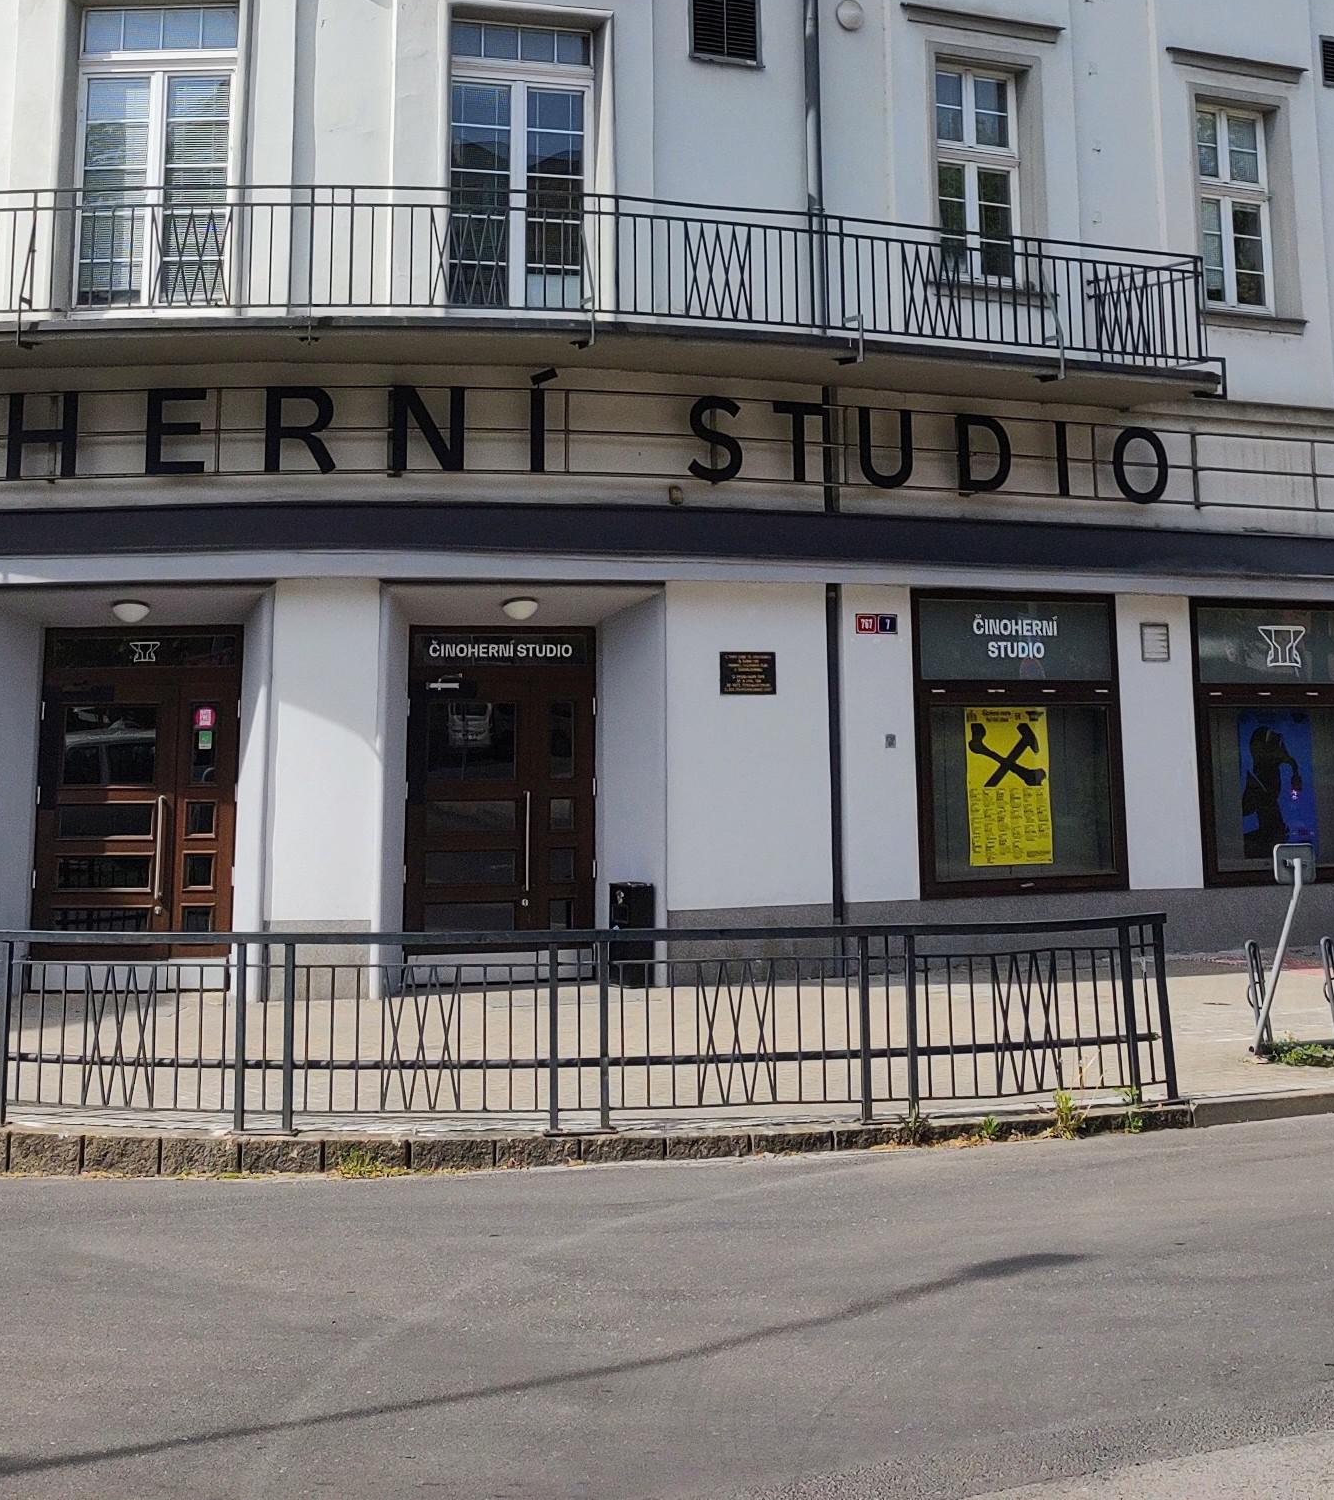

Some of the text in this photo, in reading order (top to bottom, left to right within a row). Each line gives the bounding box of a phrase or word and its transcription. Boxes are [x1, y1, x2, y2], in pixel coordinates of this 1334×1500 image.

[687, 396, 1168, 504] STUDIO
[885, 618, 891, 630] 7
[972, 614, 1058, 637] ČINOHERNÍ
[429, 639, 573, 657] ČINOHERNÍ STUDIO
[987, 641, 1045, 659] STUDIO
